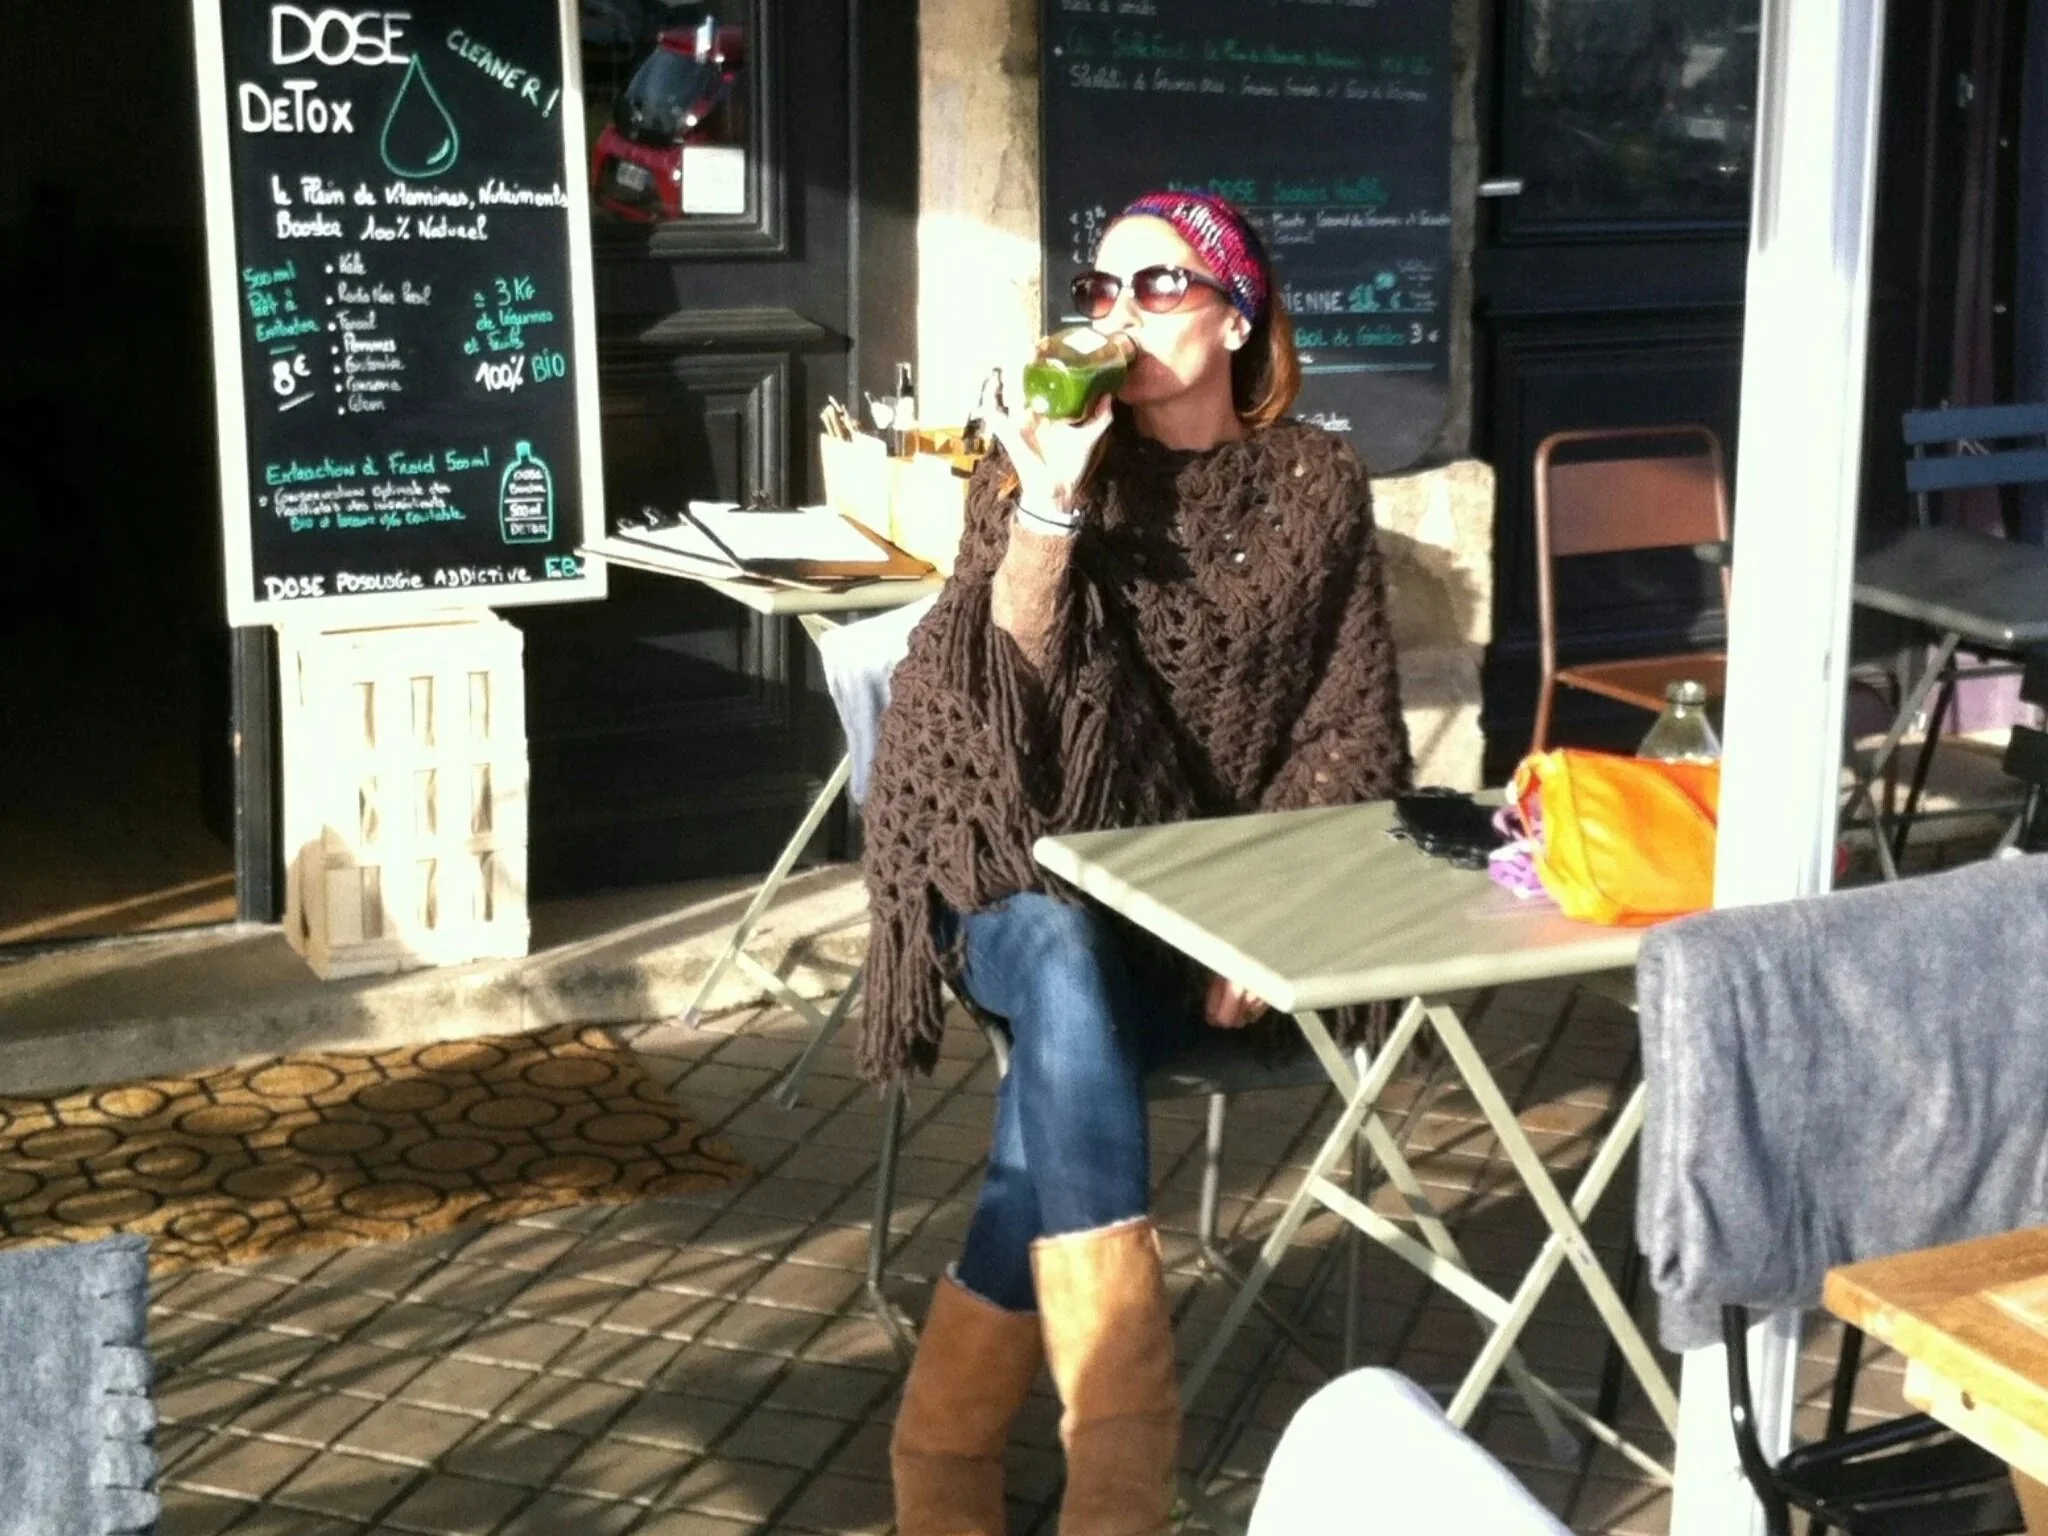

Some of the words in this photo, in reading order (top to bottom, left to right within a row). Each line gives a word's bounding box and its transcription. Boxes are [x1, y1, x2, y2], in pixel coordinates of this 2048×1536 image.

[271, 5, 412, 66] DOSE
[300, 175, 346, 206] Plein
[353, 182, 377, 206] de
[359, 213, 411, 242] 100%
[418, 213, 488, 241] Naturel
[495, 278, 512, 306] 3
[474, 354, 526, 393] 100%
[263, 574, 326, 601] DOSE
